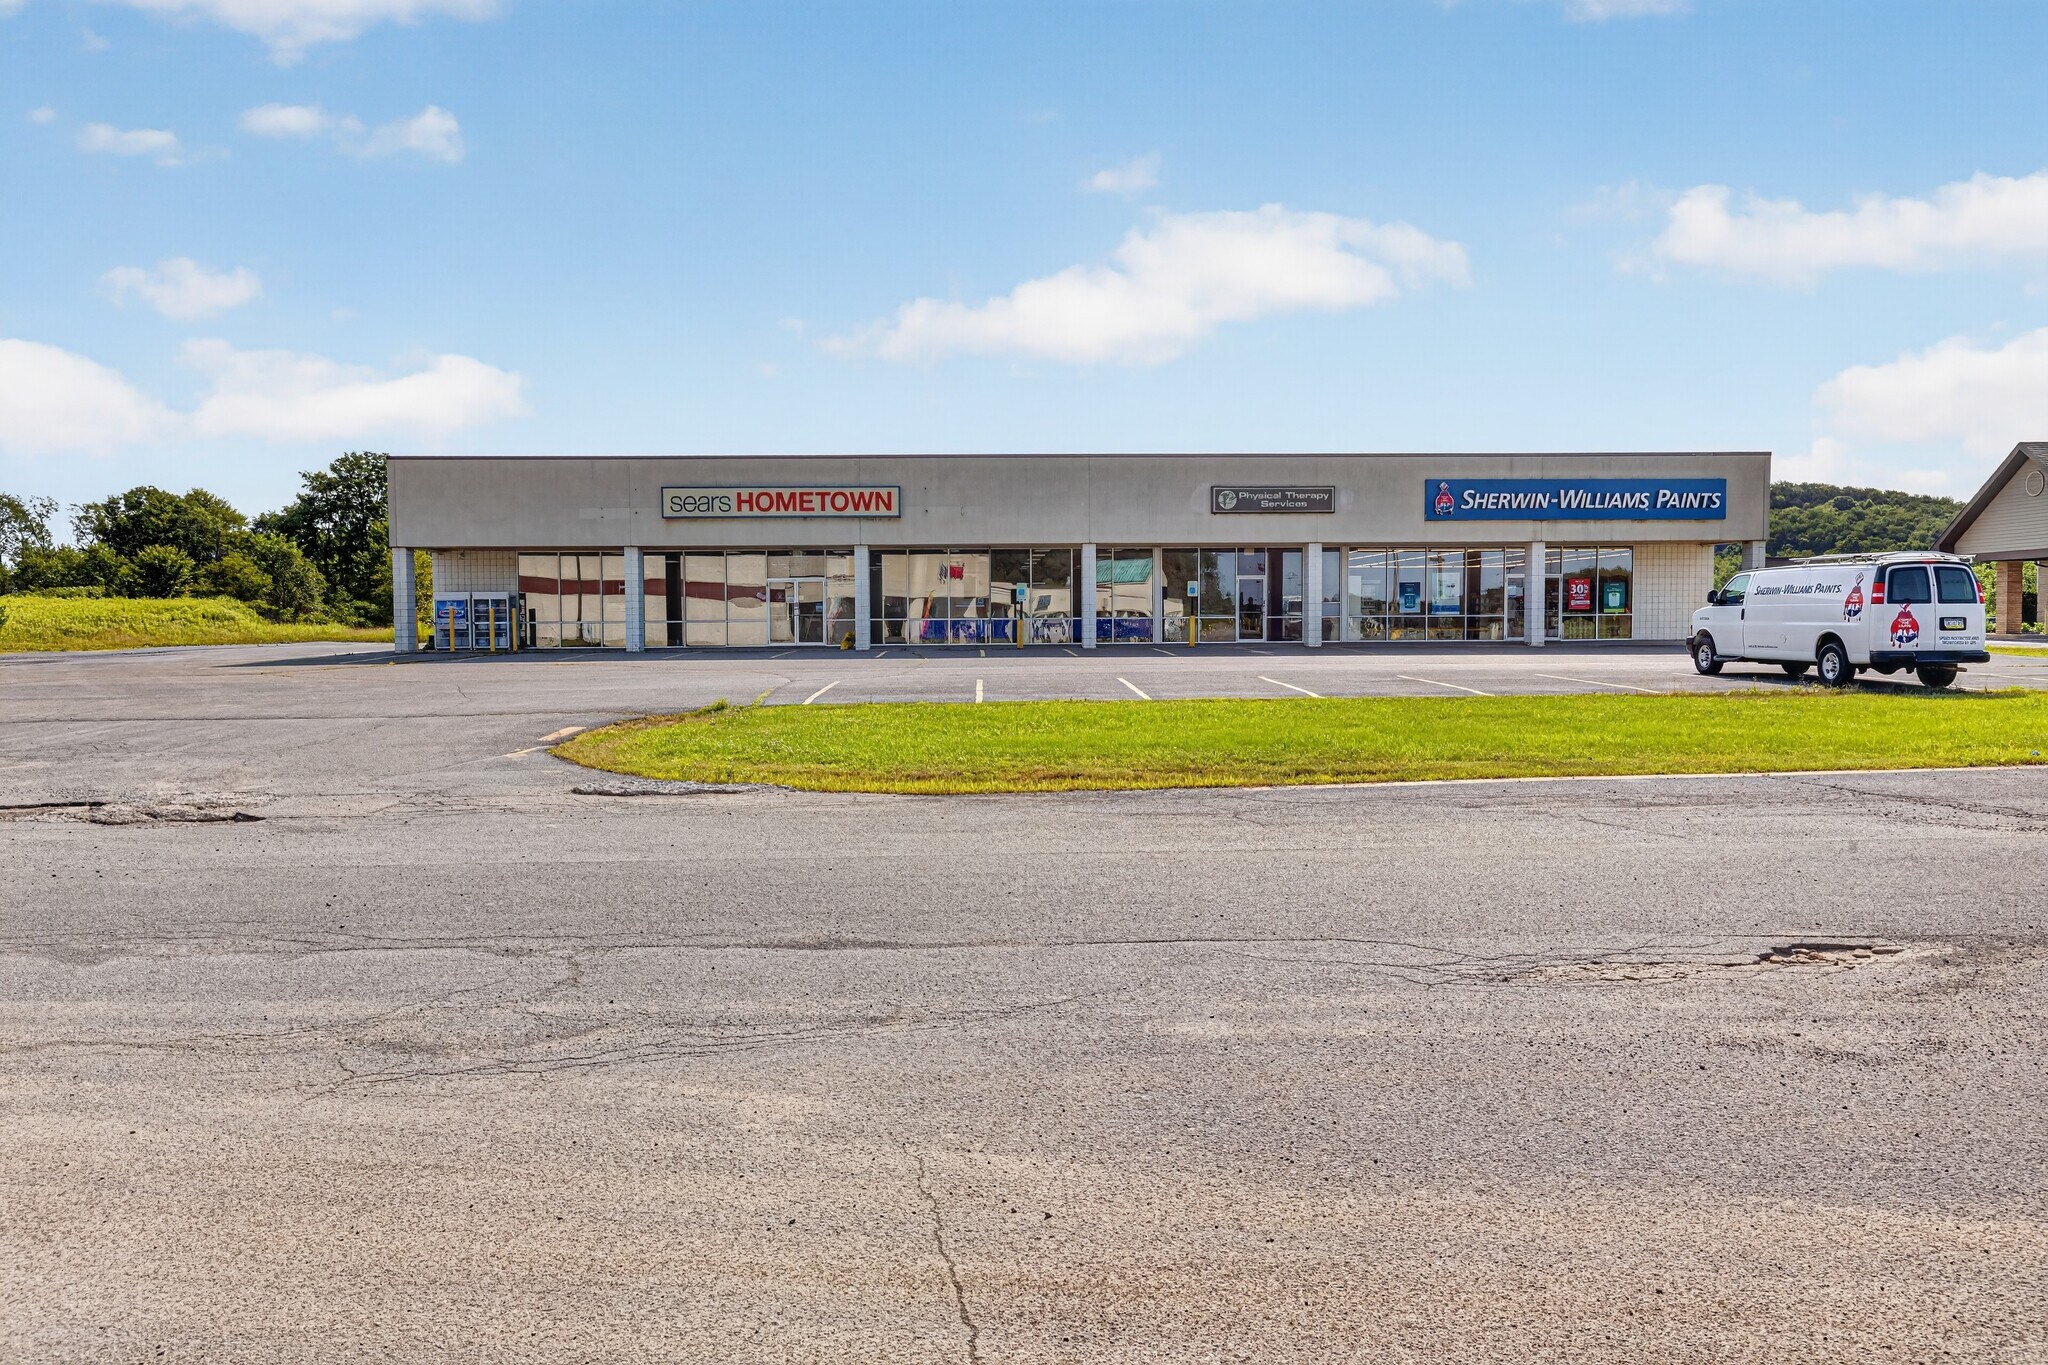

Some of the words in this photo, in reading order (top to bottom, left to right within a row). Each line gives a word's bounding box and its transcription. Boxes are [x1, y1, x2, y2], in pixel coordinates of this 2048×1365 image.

[1239, 491, 1281, 500] Physical
[1285, 491, 1330, 500] Therapy
[1461, 489, 1650, 510] SHERWIN-WILLIAMS
[1656, 489, 1722, 509] PAINTS
[670, 495, 731, 512] sears
[736, 491, 893, 512] HOMETOWN
[1260, 500, 1308, 508] Services
[1754, 584, 1814, 595] SHERWIN-WILLIAMS
